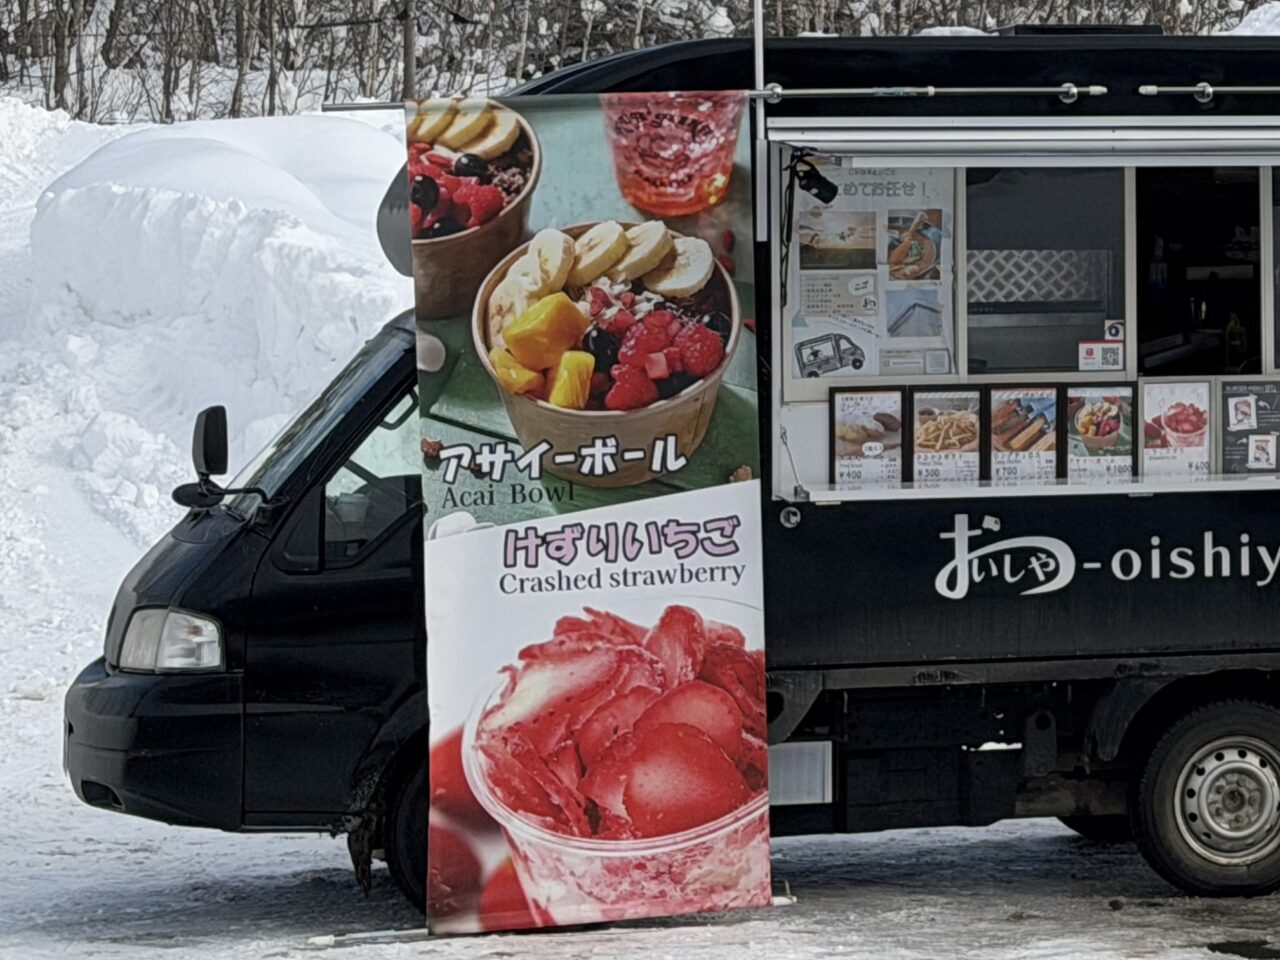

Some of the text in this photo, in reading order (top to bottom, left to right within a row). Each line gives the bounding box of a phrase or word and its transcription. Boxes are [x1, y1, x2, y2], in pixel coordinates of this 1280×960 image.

[440, 434, 688, 484] アサイーボール
[441, 481, 574, 509] Acai Bowl
[503, 515, 741, 568] けずりいちご
[499, 563, 746, 595] Crashed strawberry
